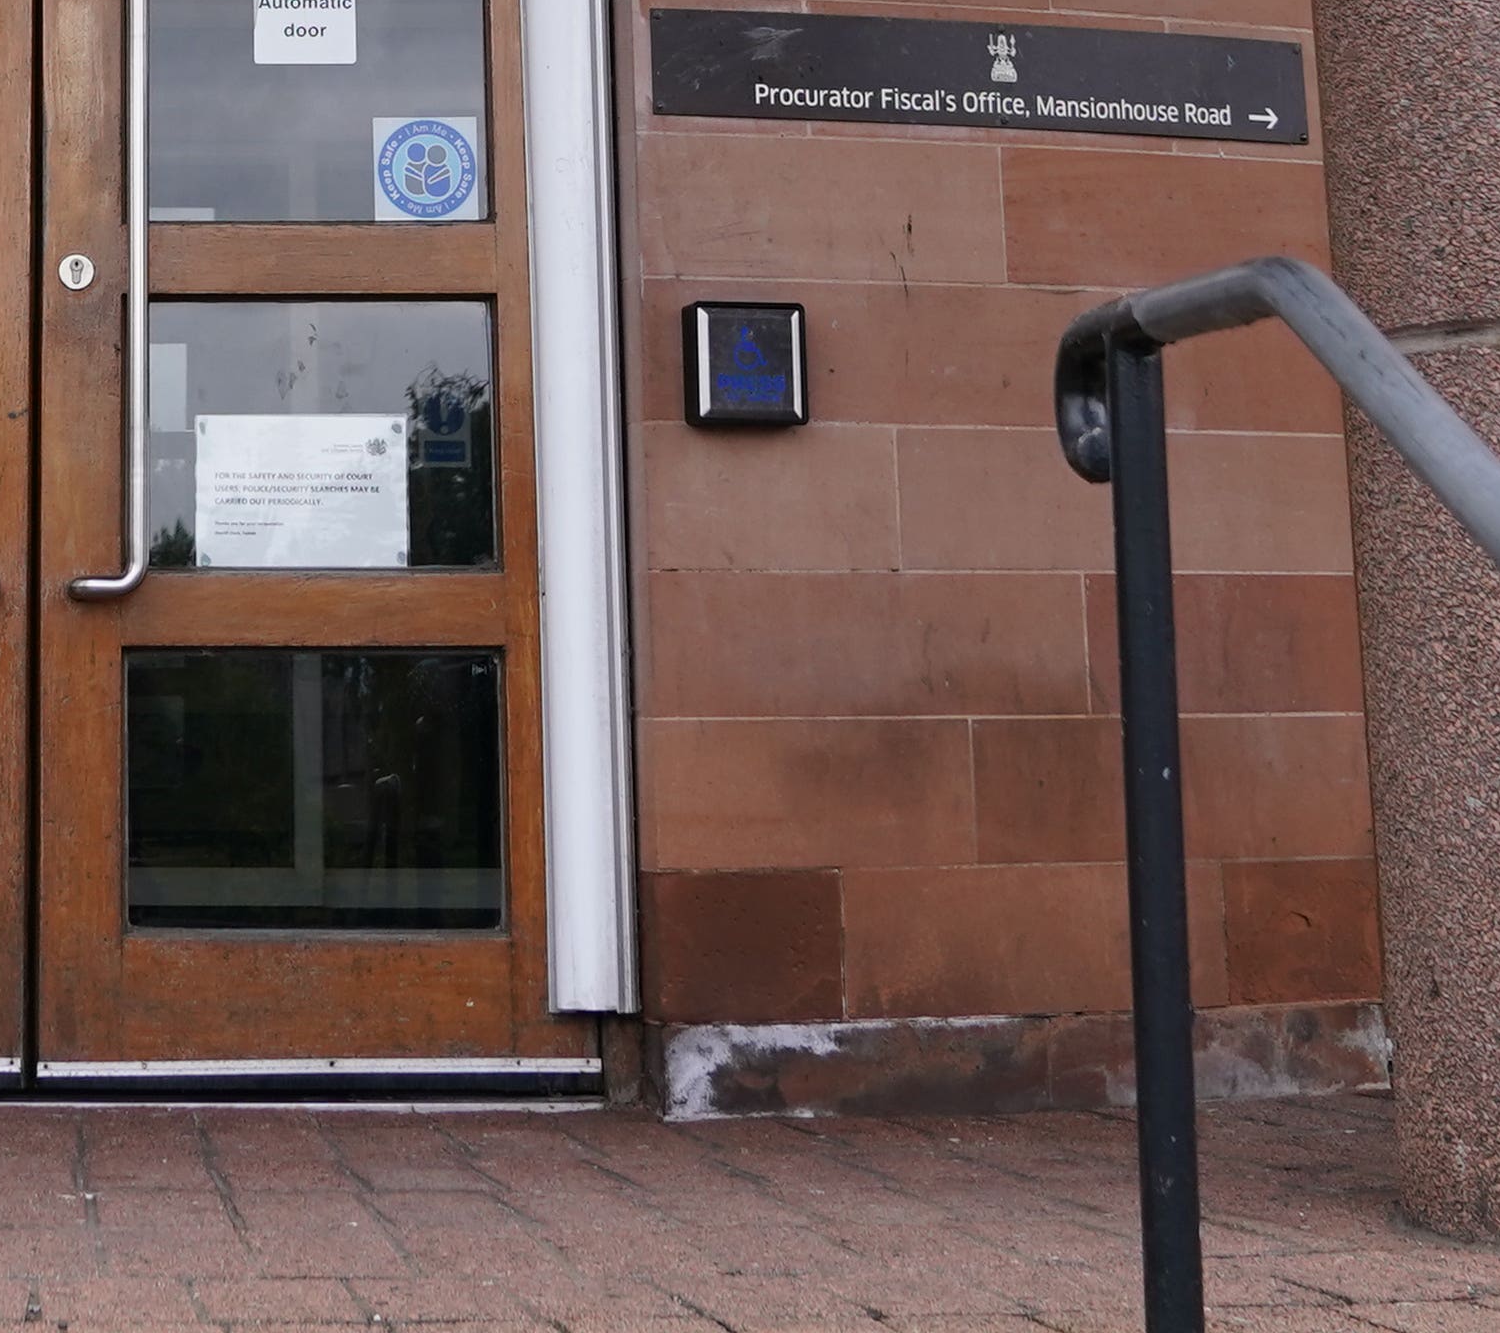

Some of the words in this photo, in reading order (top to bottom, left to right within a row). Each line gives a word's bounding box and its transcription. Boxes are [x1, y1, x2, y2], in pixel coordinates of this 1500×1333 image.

[283, 21, 327, 39] door
[755, 83, 873, 108] Procurator
[881, 88, 957, 112] Fiscal's
[962, 92, 1030, 118] Office,
[1036, 95, 1179, 123] Mansionhouse
[1185, 103, 1231, 126] Road
[412, 125, 428, 133] Am
[431, 124, 448, 136] Me
[381, 140, 399, 166] Safe
[454, 138, 470, 169] Keep
[383, 170, 400, 201] Keep
[454, 173, 472, 199] Safe
[215, 472, 230, 480] FOR
[232, 472, 246, 480] THE
[249, 472, 277, 480] SAFETY
[277, 472, 295, 480] AND
[296, 472, 332, 480] SECURITY
[346, 473, 373, 481] COURT
[310, 485, 349, 493] SEARCHES
[350, 486, 369, 494] MAY
[370, 486, 380, 494] BE
[214, 497, 248, 506] CARRIED
[249, 497, 266, 506] OUT
